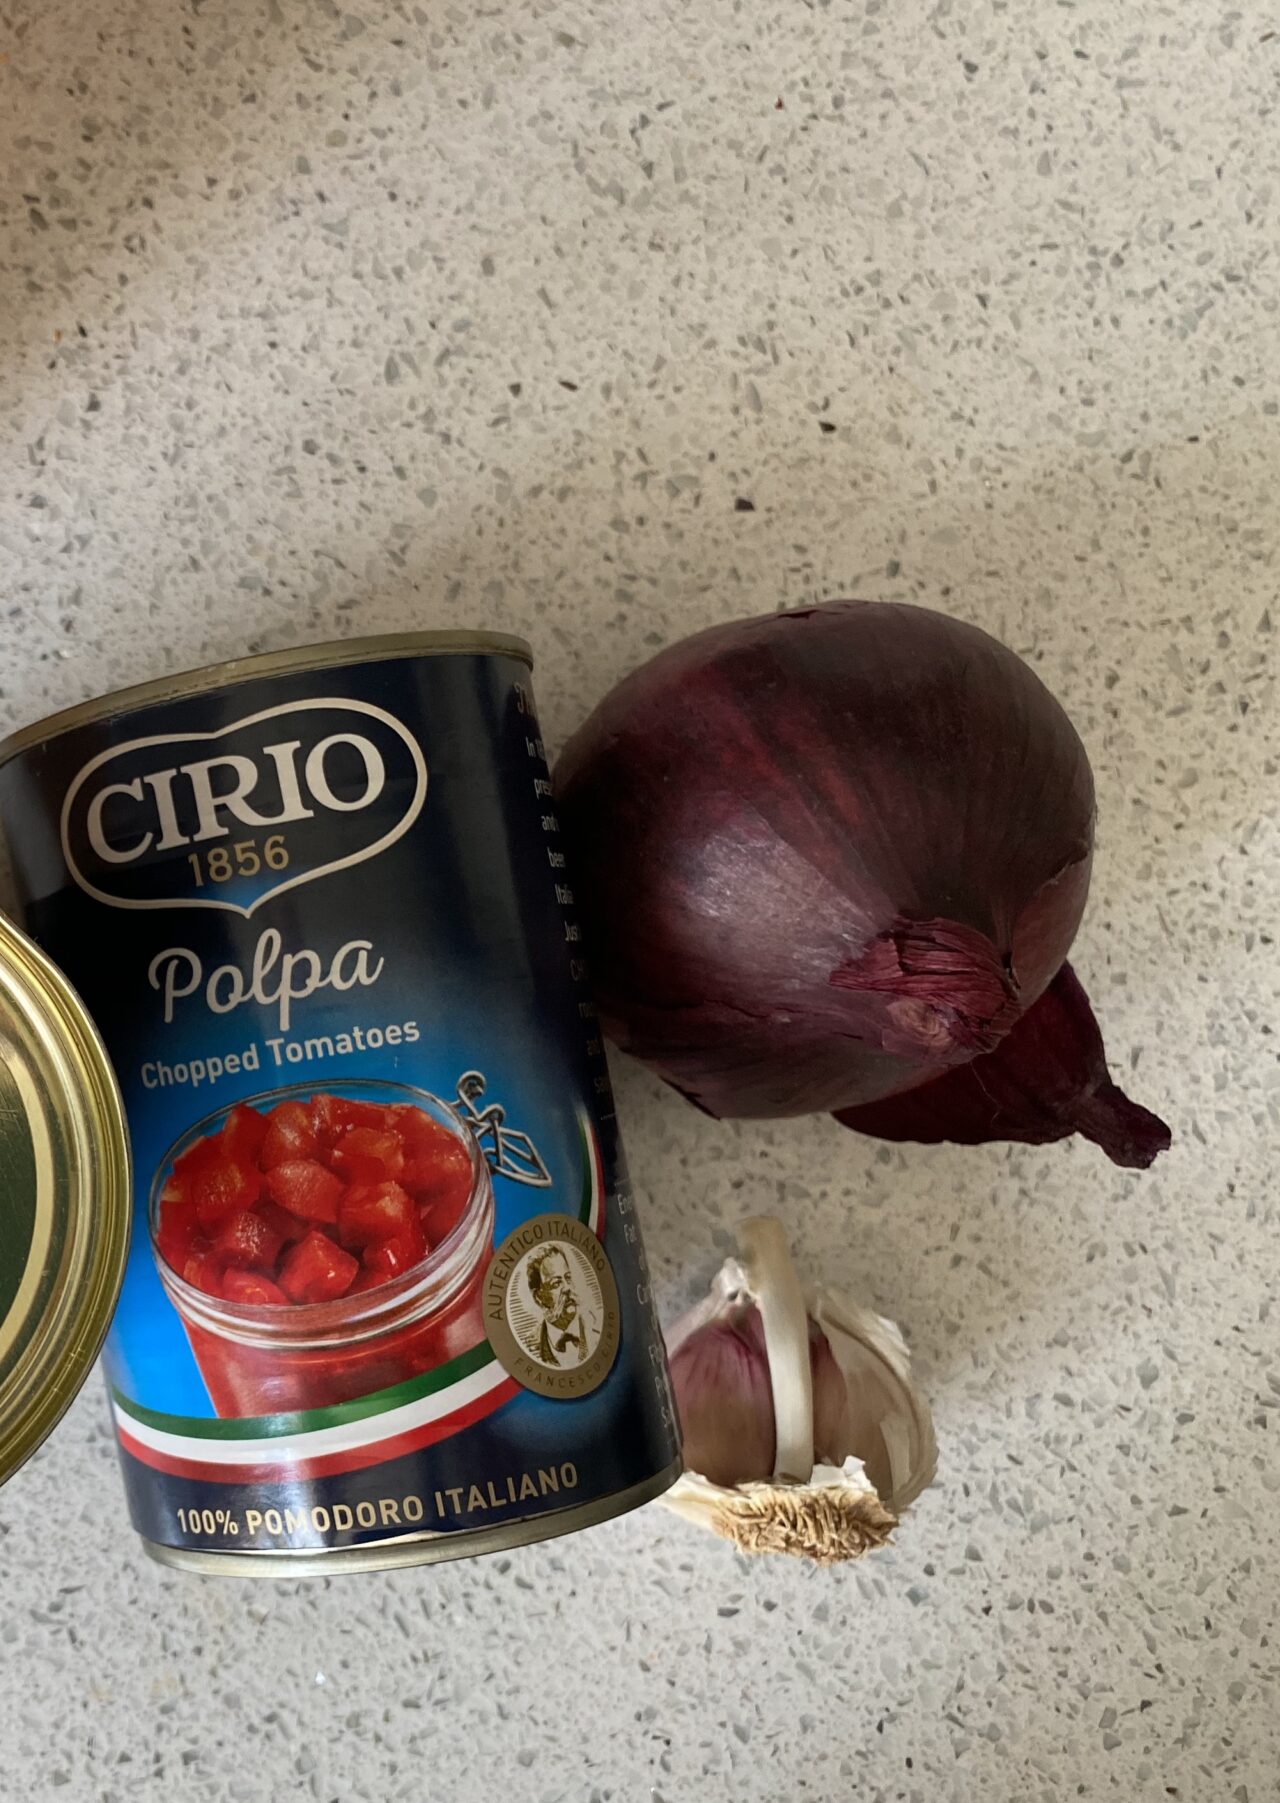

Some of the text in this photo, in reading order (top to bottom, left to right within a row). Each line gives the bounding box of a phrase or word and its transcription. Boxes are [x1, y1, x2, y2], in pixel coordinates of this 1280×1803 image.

[86, 733, 385, 864] CIRIO
[188, 835, 290, 887] 1856
[148, 928, 384, 1031] Polpa
[140, 1018, 420, 1089] Chopped Tomatoes
[488, 1220, 605, 1321] AUTENTICO ITALIANO
[514, 1357, 601, 1389] FRANCESCO
[177, 1462, 578, 1536] 100% POMODORO ITALIANO
